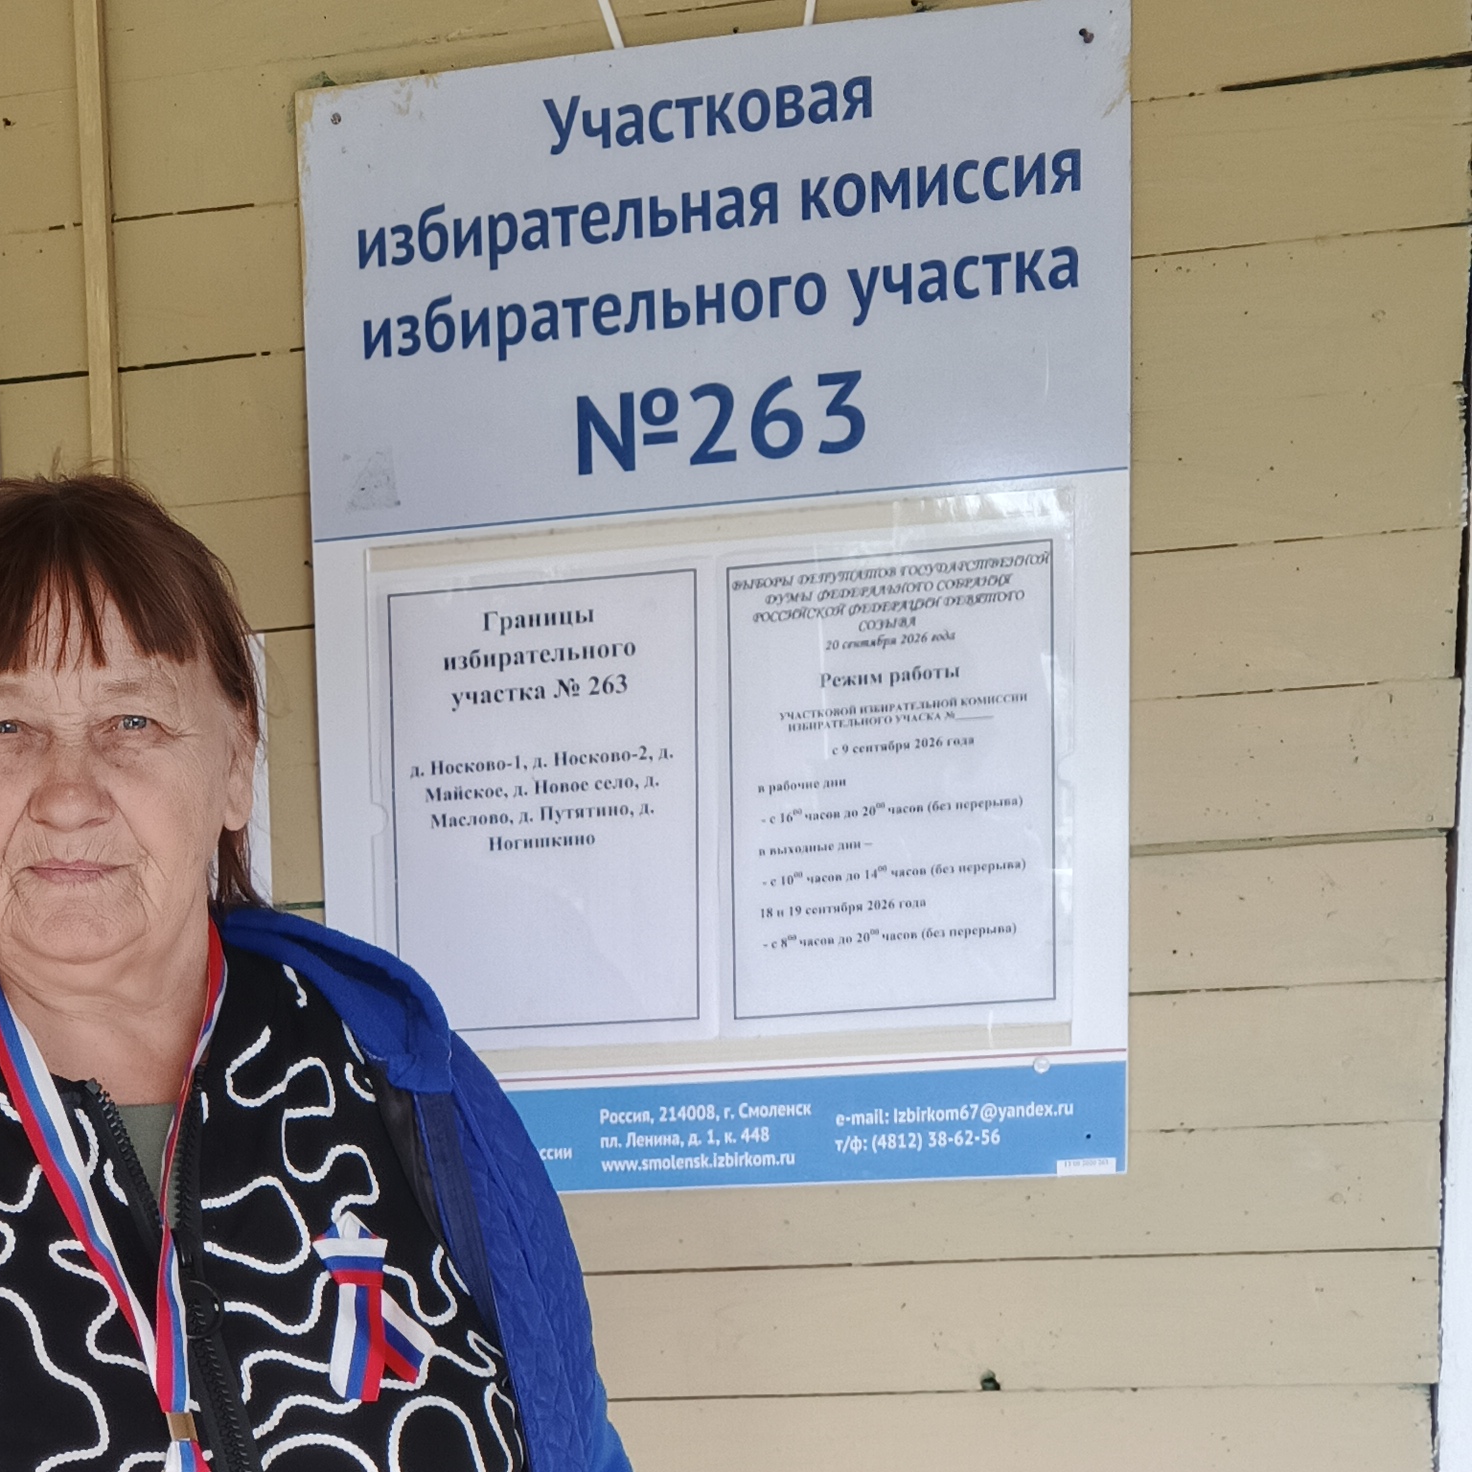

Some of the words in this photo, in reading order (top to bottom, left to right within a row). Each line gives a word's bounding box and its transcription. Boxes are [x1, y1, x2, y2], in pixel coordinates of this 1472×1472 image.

[543, 75, 874, 155] Участковая
[357, 182, 778, 270] избирательная
[800, 148, 1083, 222] комиссия
[362, 271, 827, 361] избирательного
[847, 244, 1080, 326] участка
[577, 369, 867, 476] №263
[482, 608, 595, 636] Границы
[826, 639, 840, 650] 20
[842, 634, 897, 650] сентября
[900, 632, 928, 645] 2026
[931, 629, 956, 642] года
[443, 641, 637, 672] избирательного
[820, 672, 883, 688] Режим
[889, 665, 960, 687] работы
[451, 683, 546, 712] участка
[553, 678, 581, 699] №
[588, 673, 629, 696] 263
[779, 705, 856, 721] УЧАСТКОВОЙ
[859, 697, 957, 715] ИЗБИРАТЕЛЬНОЙ
[960, 693, 1028, 707] КОМИССИИ
[788, 715, 893, 732] ИЗБИРАТЕЛЬНОГО
[896, 711, 941, 724] УЧАСКА
[852, 739, 910, 754] сентября
[915, 736, 944, 749] 2026
[947, 736, 975, 747] года
[410, 765, 425, 779] д.
[430, 755, 529, 777] Носково-1,
[532, 756, 548, 770] д.
[553, 745, 654, 768] Носково-2,
[658, 746, 674, 760] д.
[425, 784, 509, 803] Майское,
[513, 785, 529, 798] д.
[534, 779, 589, 796] Новое
[594, 777, 640, 792] село,
[644, 774, 660, 789] д.
[768, 780, 820, 795] рабочие
[823, 778, 846, 790] дни
[430, 812, 514, 829] Маслово,
[518, 810, 534, 824] д.
[539, 804, 635, 824] Путятино,
[639, 802, 655, 816] д.
[804, 811, 841, 822] часов
[844, 810, 859, 820] до
[888, 803, 924, 815] часов
[927, 800, 952, 814] (без
[955, 795, 1024, 812] перерыва)
[488, 833, 596, 852] Ногишкино
[769, 843, 834, 856] выходные
[837, 840, 861, 851] дни
[807, 874, 843, 884] часов
[846, 871, 860, 882] до
[891, 867, 927, 878] часов
[930, 863, 955, 877] (без
[958, 858, 1026, 875] перерыва)
[760, 907, 773, 919] 18
[788, 905, 802, 917] 19
[805, 902, 863, 916] сентября
[866, 899, 895, 911] 2026
[898, 899, 927, 910] года
[799, 937, 835, 948] часов
[838, 935, 853, 946] до
[882, 930, 918, 941] часов
[921, 927, 946, 940] (без
[949, 922, 1017, 939] перерыва)
[599, 1108, 655, 1125] Россия,
[659, 1104, 720, 1122] 214008,
[738, 1102, 812, 1118] Смоленск
[835, 1108, 890, 1127] e-mail:
[600, 1137, 622, 1149] пл.
[626, 1131, 684, 1148] Ленина,
[688, 1134, 703, 1147] д.
[707, 1129, 721, 1146] 1,
[724, 1132, 737, 1144] к.
[740, 1126, 770, 1143] 448
[835, 1136, 868, 1155] т/ф:
[871, 1131, 923, 1153] (4812)
[928, 1128, 1001, 1147] 38-62-56
[601, 1151, 796, 1172] www.smolensk.izbirkom.ru
